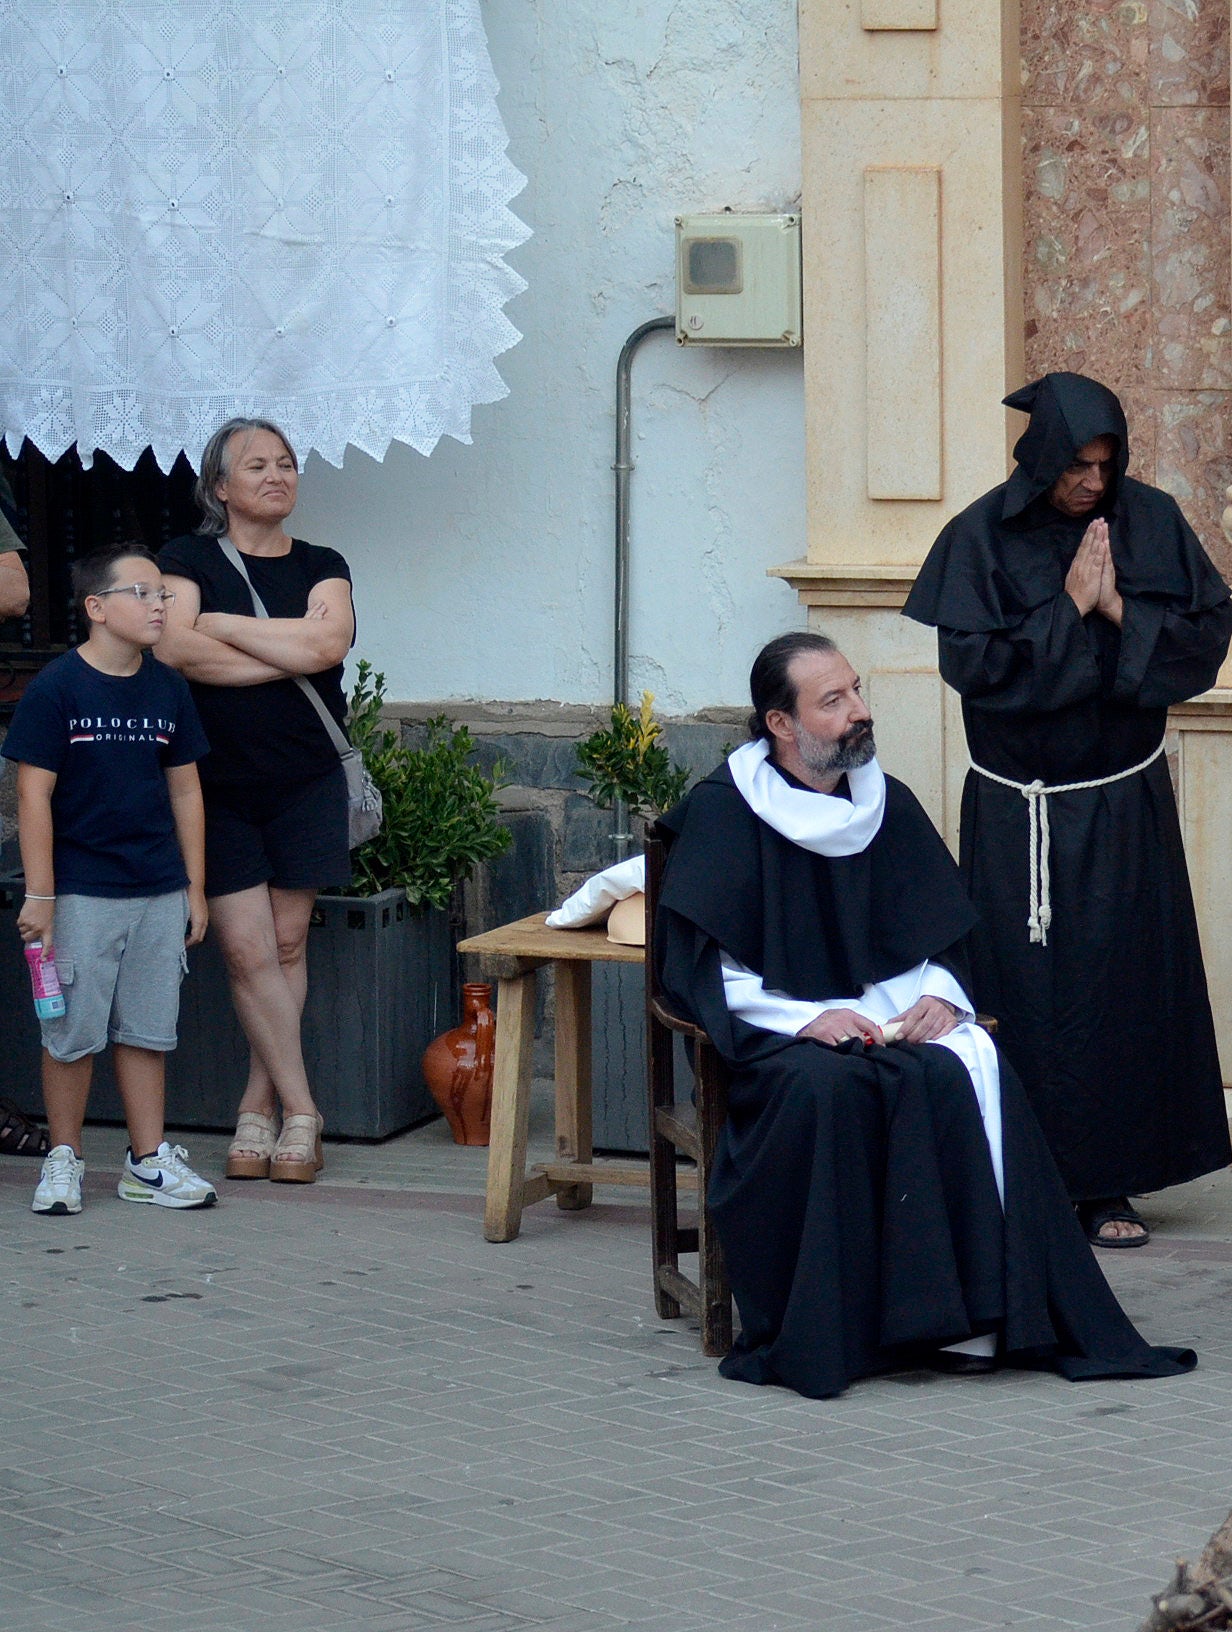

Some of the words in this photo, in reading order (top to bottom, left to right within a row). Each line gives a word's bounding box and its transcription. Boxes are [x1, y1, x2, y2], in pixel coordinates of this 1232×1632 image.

[69, 717, 121, 730] POLO
[126, 718, 176, 733] CLUB
[96, 733, 154, 742] ORIGINAL
